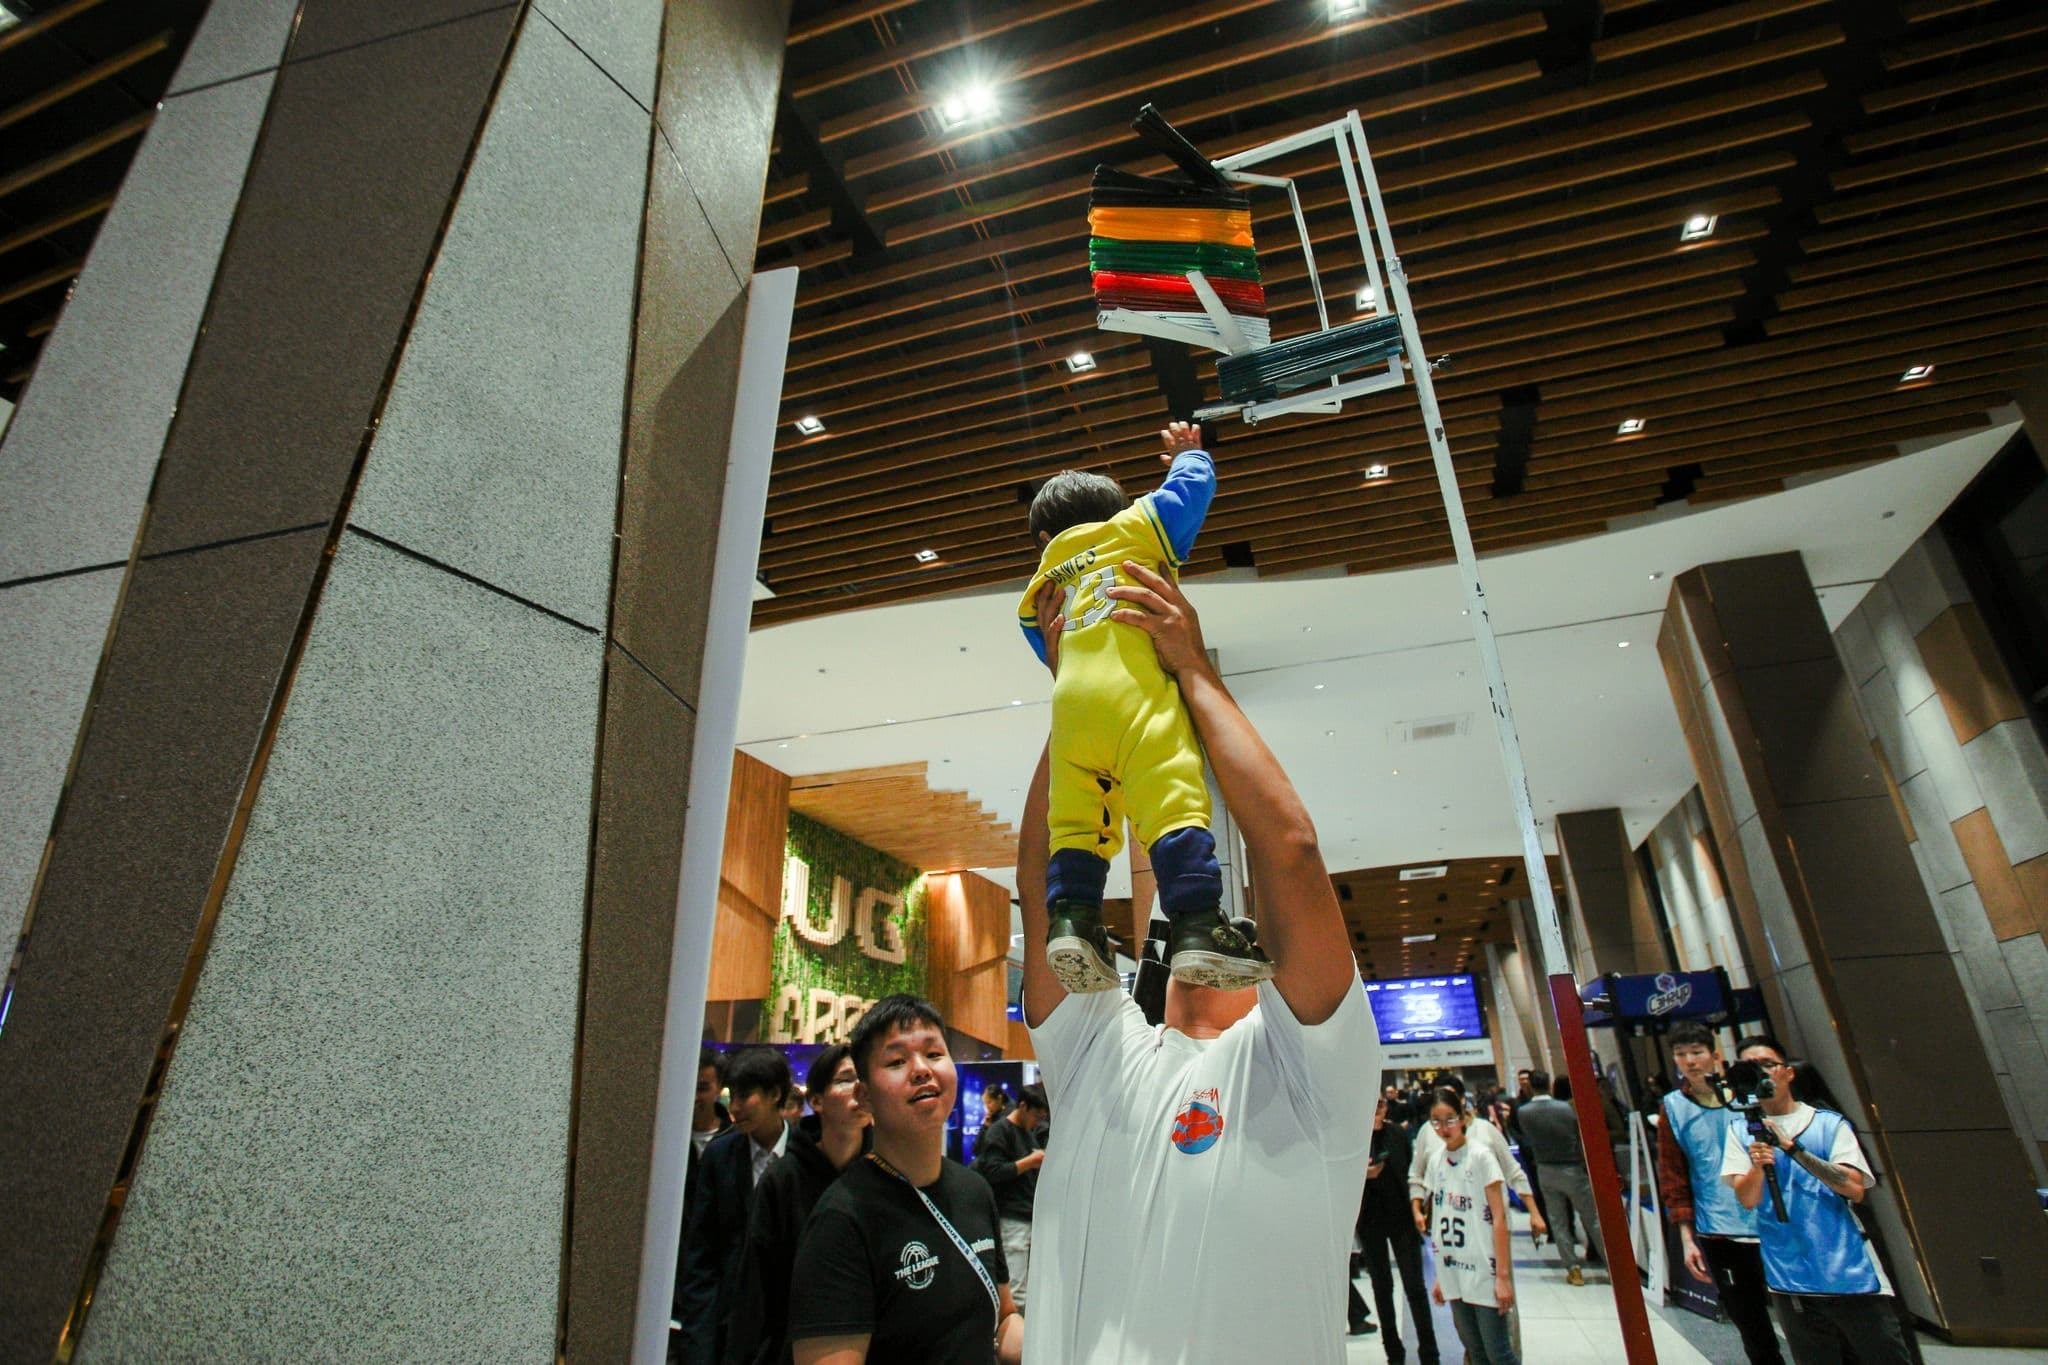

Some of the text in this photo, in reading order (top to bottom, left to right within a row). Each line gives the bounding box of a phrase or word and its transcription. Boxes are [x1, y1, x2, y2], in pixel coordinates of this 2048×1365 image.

[784, 856, 907, 965] UG
[1440, 1216, 1466, 1249] 25
[894, 1255, 940, 1280] THE LEAGUE
